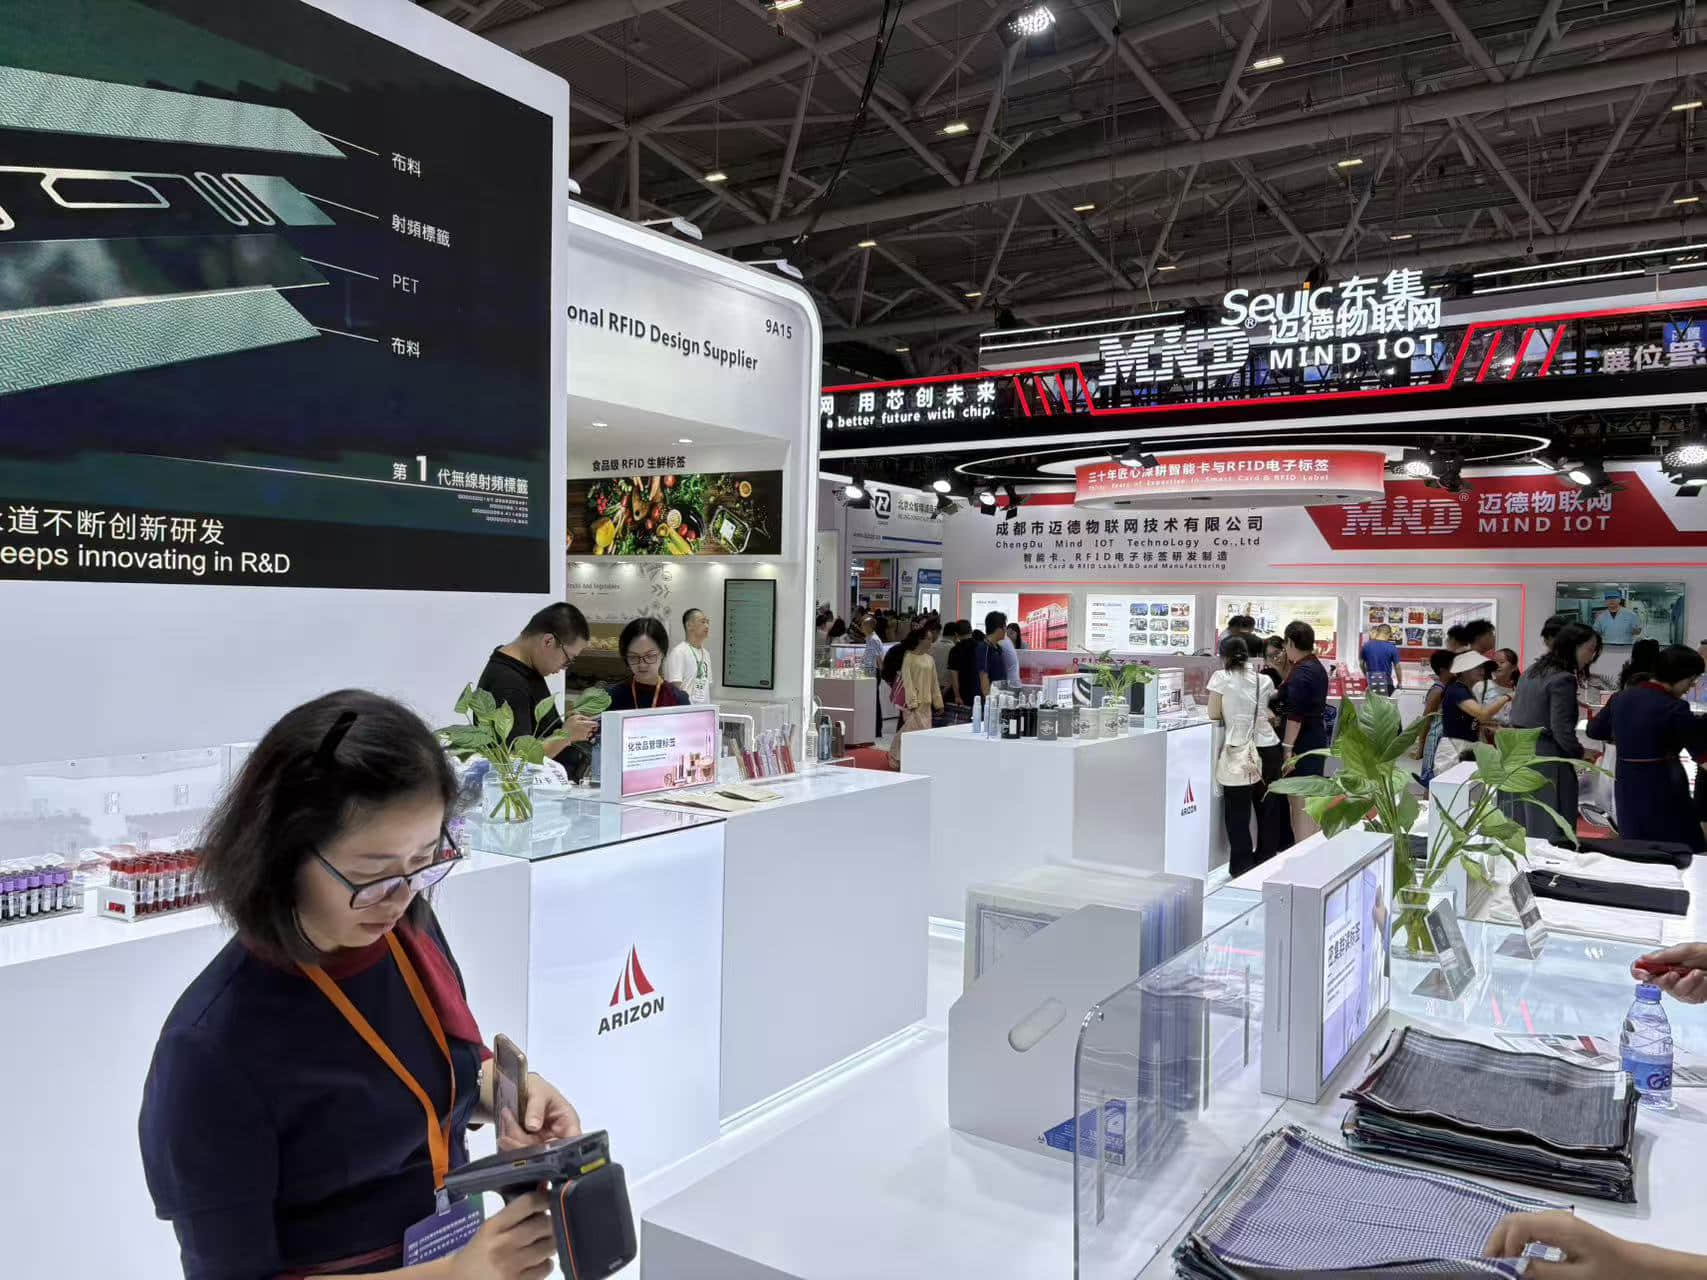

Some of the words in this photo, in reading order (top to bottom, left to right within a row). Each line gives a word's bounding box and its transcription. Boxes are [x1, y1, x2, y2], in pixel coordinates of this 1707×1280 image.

[392, 152, 421, 177] 布料
[392, 214, 451, 247] 射頻標籤
[392, 274, 419, 294] PET
[1339, 269, 1426, 309] 东集
[765, 319, 792, 339] 9A15
[1269, 296, 1441, 345] 迈德物联网
[391, 337, 421, 358] 布料
[567, 304, 604, 327] onal
[608, 312, 645, 338] RFID
[650, 325, 700, 356] Design
[703, 340, 758, 370] Supplier
[1269, 342, 1361, 370] MIND
[1377, 334, 1439, 360] IOT
[857, 381, 996, 412] 用芯创未来
[826, 419, 833, 429] a
[838, 415, 875, 427] better
[881, 412, 920, 425] future
[927, 408, 955, 421] with
[963, 404, 996, 420] chip.
[392, 462, 407, 481] 第
[416, 455, 427, 482] 1
[592, 458, 619, 472] 食品级
[621, 458, 644, 470] RFID
[647, 455, 686, 470] 生鲜标签
[1478, 490, 1612, 515] 迈德物联网
[0, 505, 225, 545] 道不断创新研发
[996, 515, 1263, 537] 成都市迈德物联网技术有限公司
[1478, 517, 1551, 533] MIND
[1563, 516, 1610, 531] IOT
[996, 540, 1043, 549] ChengDu
[1056, 538, 1083, 548] Mind
[1095, 539, 1114, 547] IOT
[0, 545, 68, 570] eeps
[78, 544, 206, 576] innovating
[214, 551, 233, 572] in
[241, 552, 290, 574] R&D
[598, 996, 665, 1036] ARIZON
